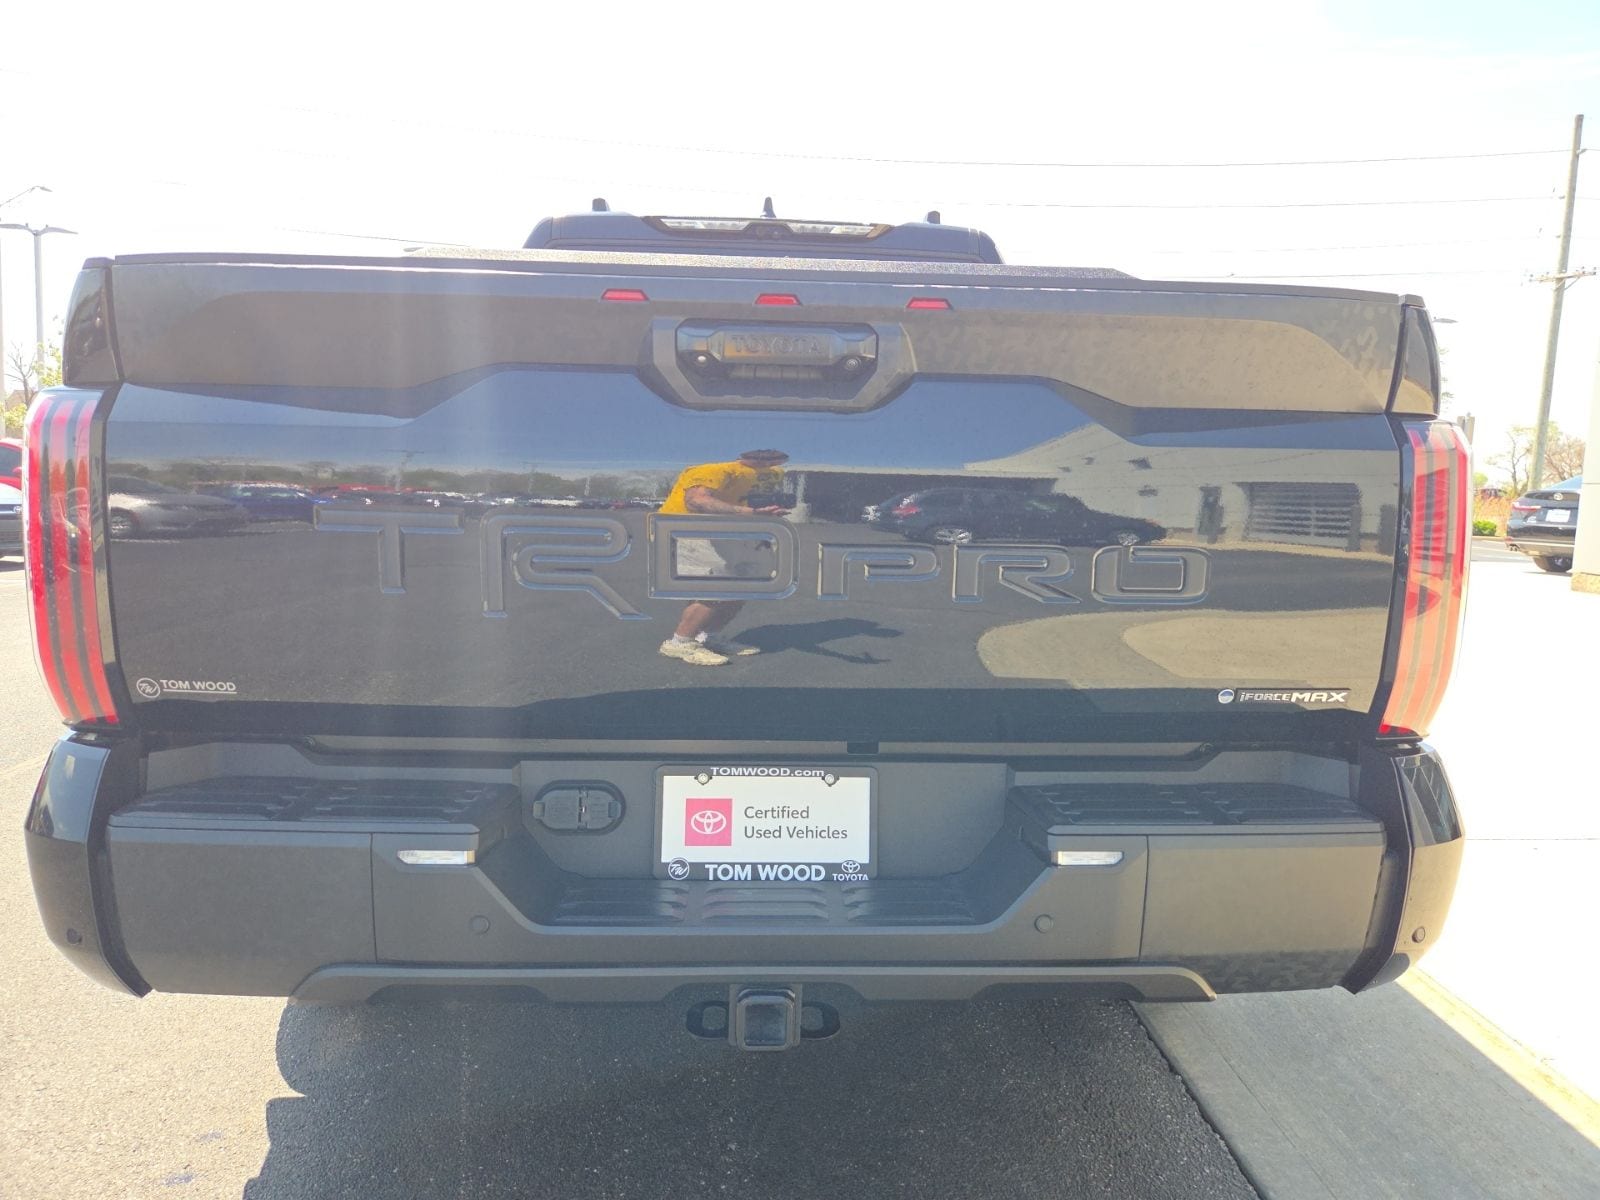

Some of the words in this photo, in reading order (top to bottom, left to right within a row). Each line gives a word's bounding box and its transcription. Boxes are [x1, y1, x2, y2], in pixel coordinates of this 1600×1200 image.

[732, 335, 819, 353] TOYOTA
[313, 505, 798, 620] TRD
[817, 543, 1211, 604] PRO
[160, 679, 191, 690] TOM
[192, 680, 237, 691] WOOD
[710, 766, 825, 778] TOMWOOD.com
[744, 806, 810, 820] Certified
[744, 826, 782, 839] Used
[786, 826, 848, 840] Vehicles
[704, 864, 752, 881] TOM
[757, 865, 826, 882] WOOD
[832, 872, 869, 882] TOYOTA
